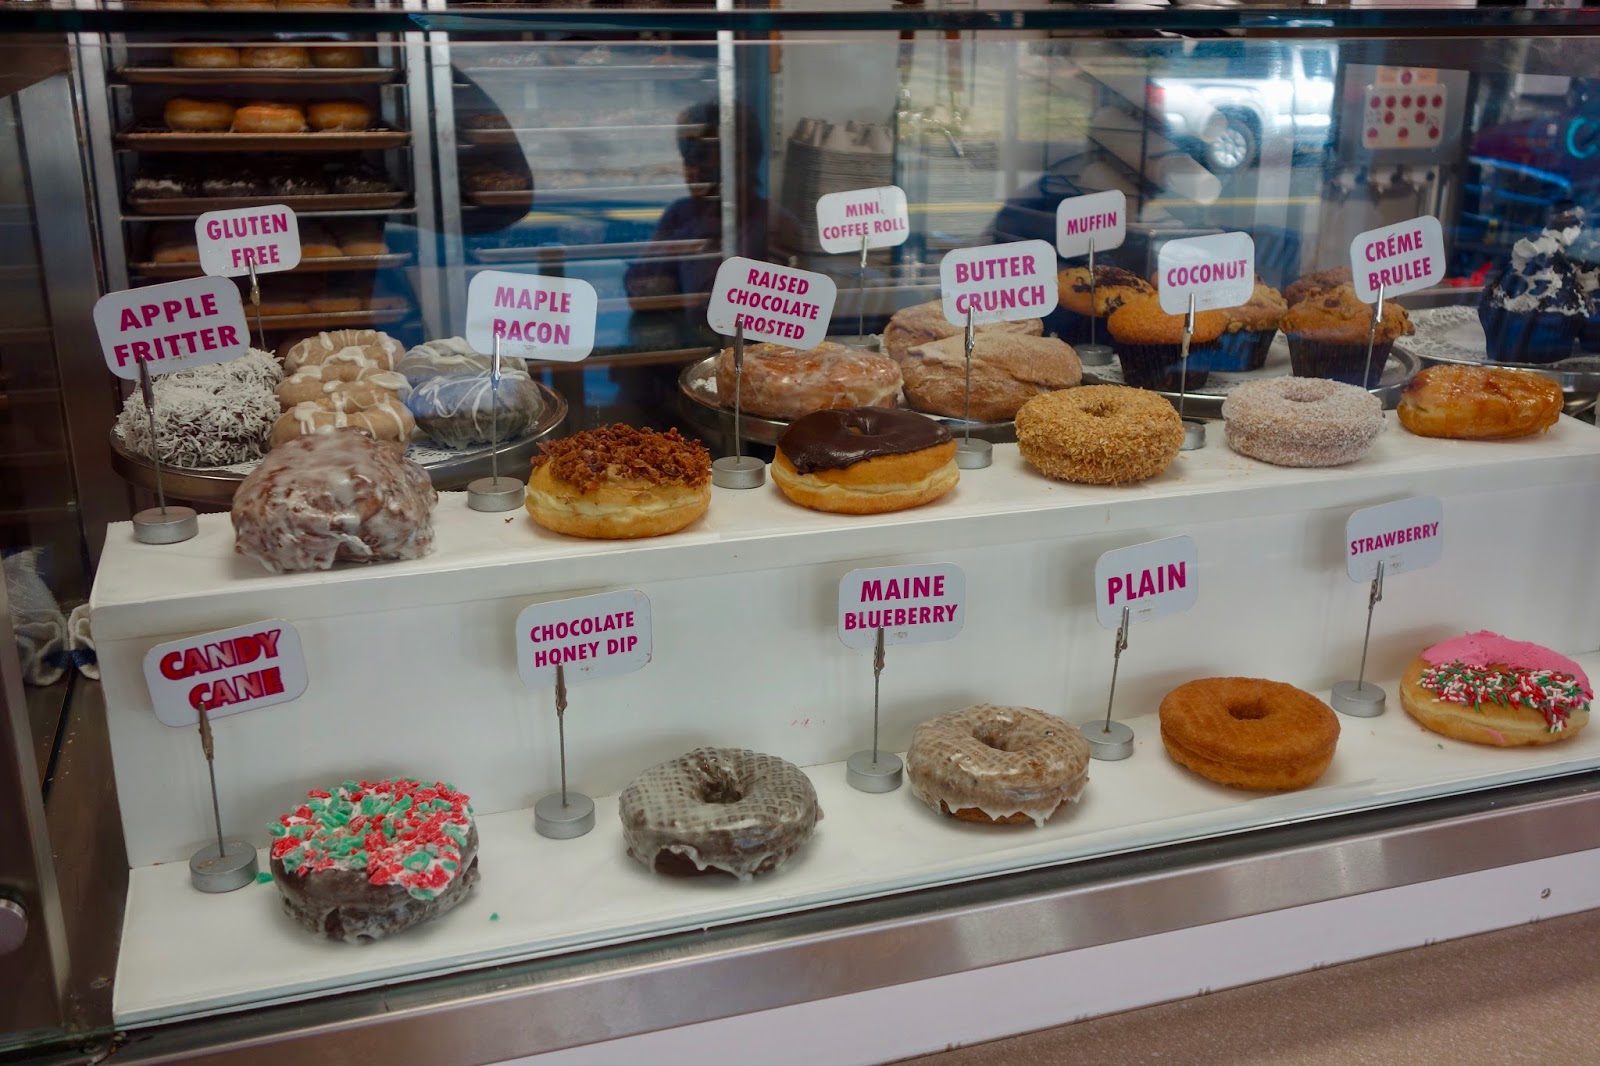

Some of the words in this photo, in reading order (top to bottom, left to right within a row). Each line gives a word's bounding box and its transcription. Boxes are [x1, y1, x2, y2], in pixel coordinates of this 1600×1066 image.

[845, 201, 880, 217] MINI
[1066, 211, 1117, 236] MUFFIN
[206, 213, 288, 240] GLUTEN
[823, 221, 869, 240] COFFEE
[873, 217, 906, 234] ROLL
[231, 244, 280, 268] FREE
[1365, 230, 1423, 263] CRÉME
[747, 268, 809, 295] RAISED
[955, 255, 1036, 284] BUTTER
[1167, 259, 1247, 287] COCONUT
[1368, 256, 1432, 292] BRULEE
[120, 293, 219, 332] APPLE
[494, 286, 572, 314] MAPLE
[726, 288, 820, 320] CHOCOLATE
[955, 285, 1045, 315] CRUNCH
[493, 318, 571, 346] BACON
[734, 313, 805, 340] FROSTED
[113, 325, 240, 368] FRITTER
[1350, 521, 1439, 556] STRAWBERRY
[860, 575, 945, 603] MAINE
[1107, 560, 1186, 606] PLAIN
[530, 611, 634, 643] CHOCOLATE
[844, 604, 959, 631] BLUEBERRY
[159, 628, 282, 681] CANDY
[534, 641, 600, 668] HONEY
[606, 635, 638, 655] DIP
[188, 666, 286, 712] CANE
